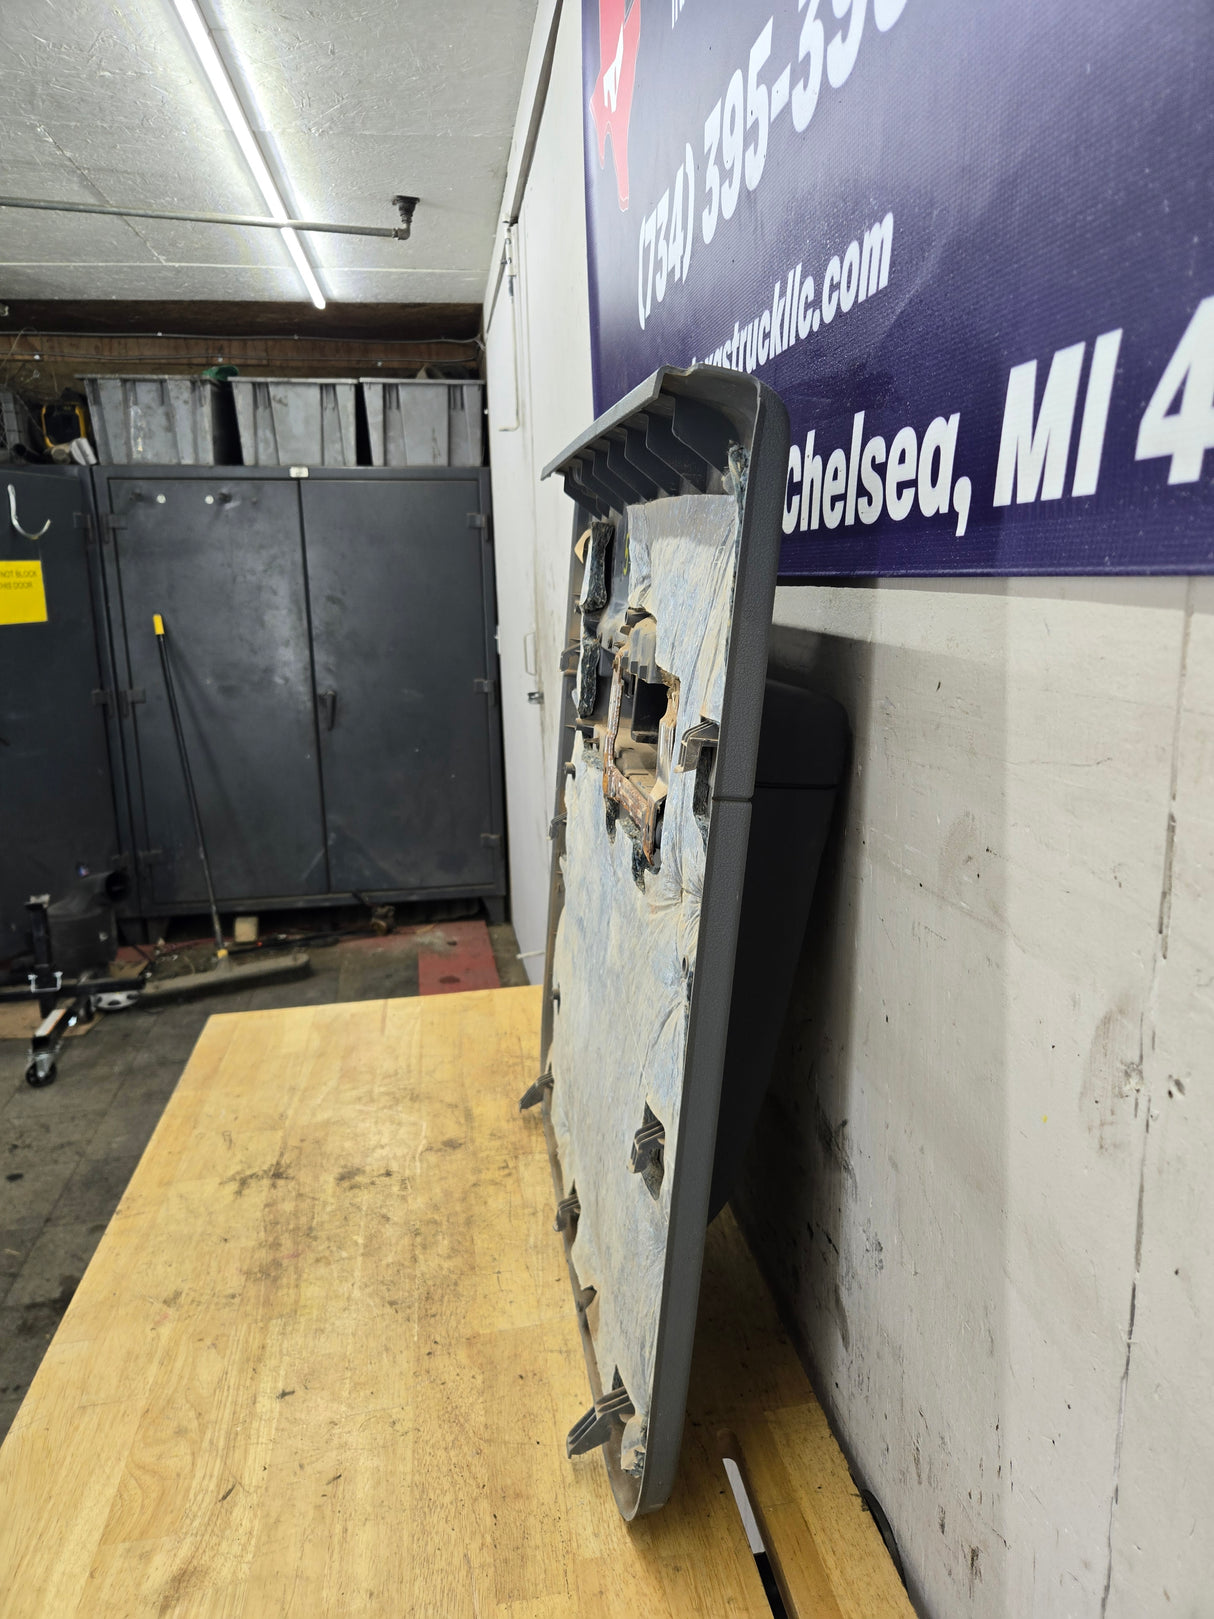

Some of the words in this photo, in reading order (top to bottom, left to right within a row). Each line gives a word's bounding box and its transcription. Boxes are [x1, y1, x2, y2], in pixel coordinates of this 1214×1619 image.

[638, 142, 695, 330] (734)
[702, 0, 908, 244] 395-3
[782, 410, 972, 537] Chelsea,
[993, 327, 1123, 507] MI
